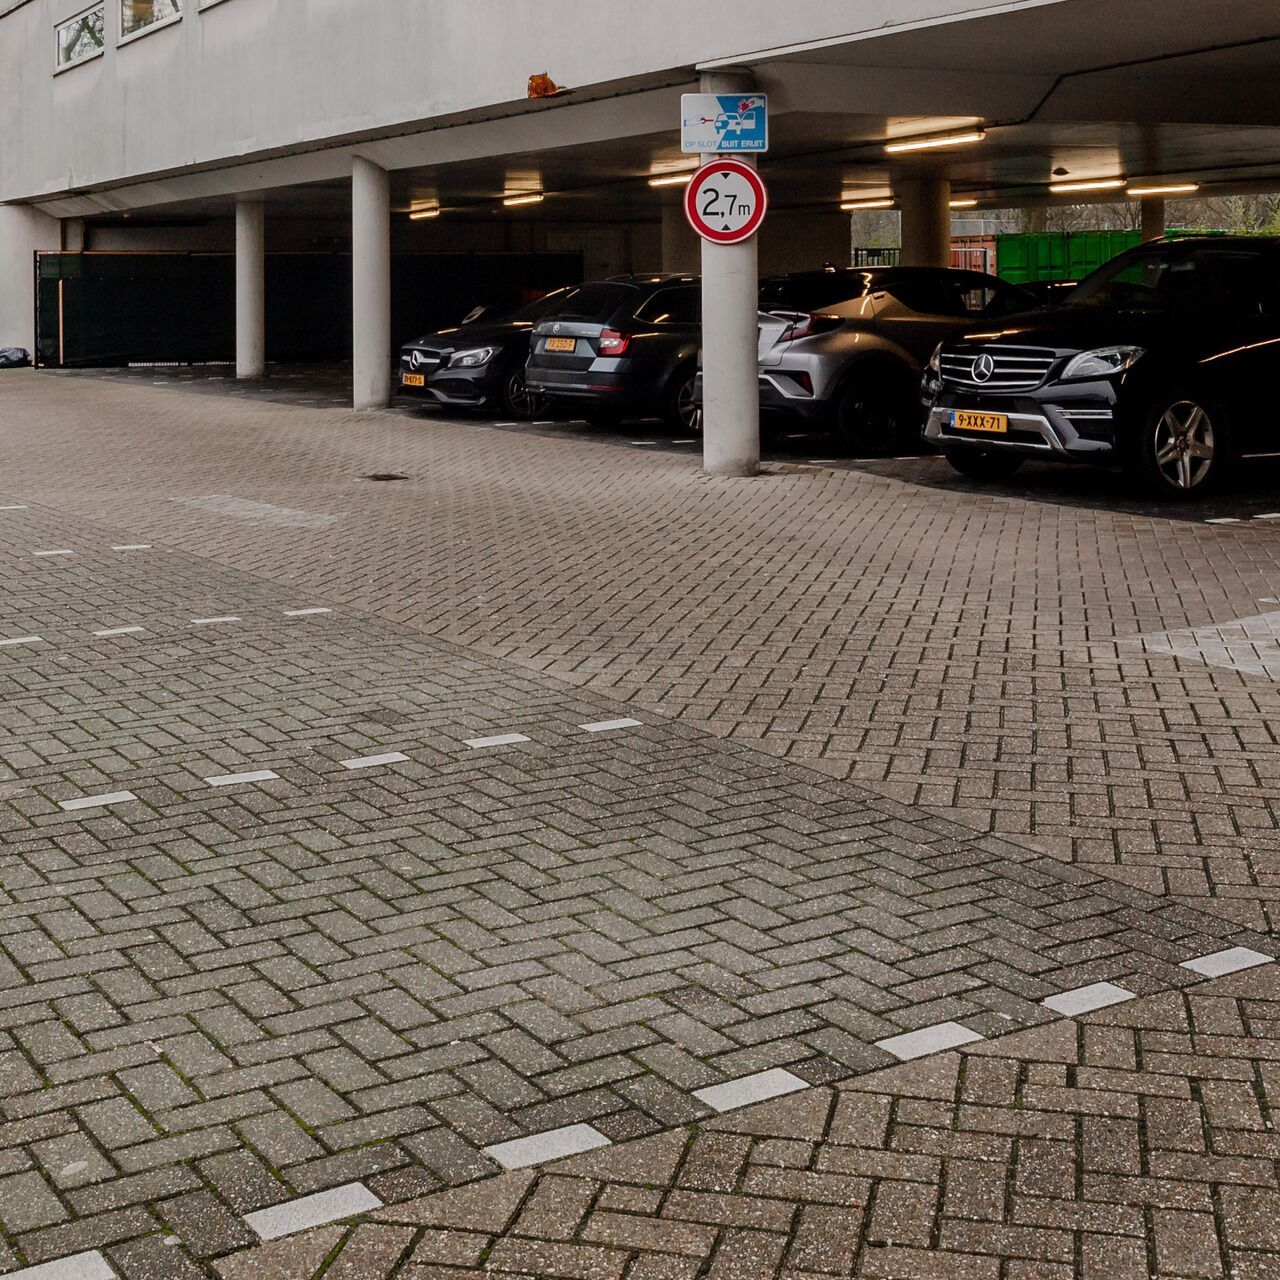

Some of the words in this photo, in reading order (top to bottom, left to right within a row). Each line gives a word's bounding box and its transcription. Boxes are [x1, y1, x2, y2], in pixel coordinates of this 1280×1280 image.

[721, 140, 739, 148] BUIT
[741, 140, 763, 148] ERUIT
[958, 413, 1000, 430] 9-XXX-71
